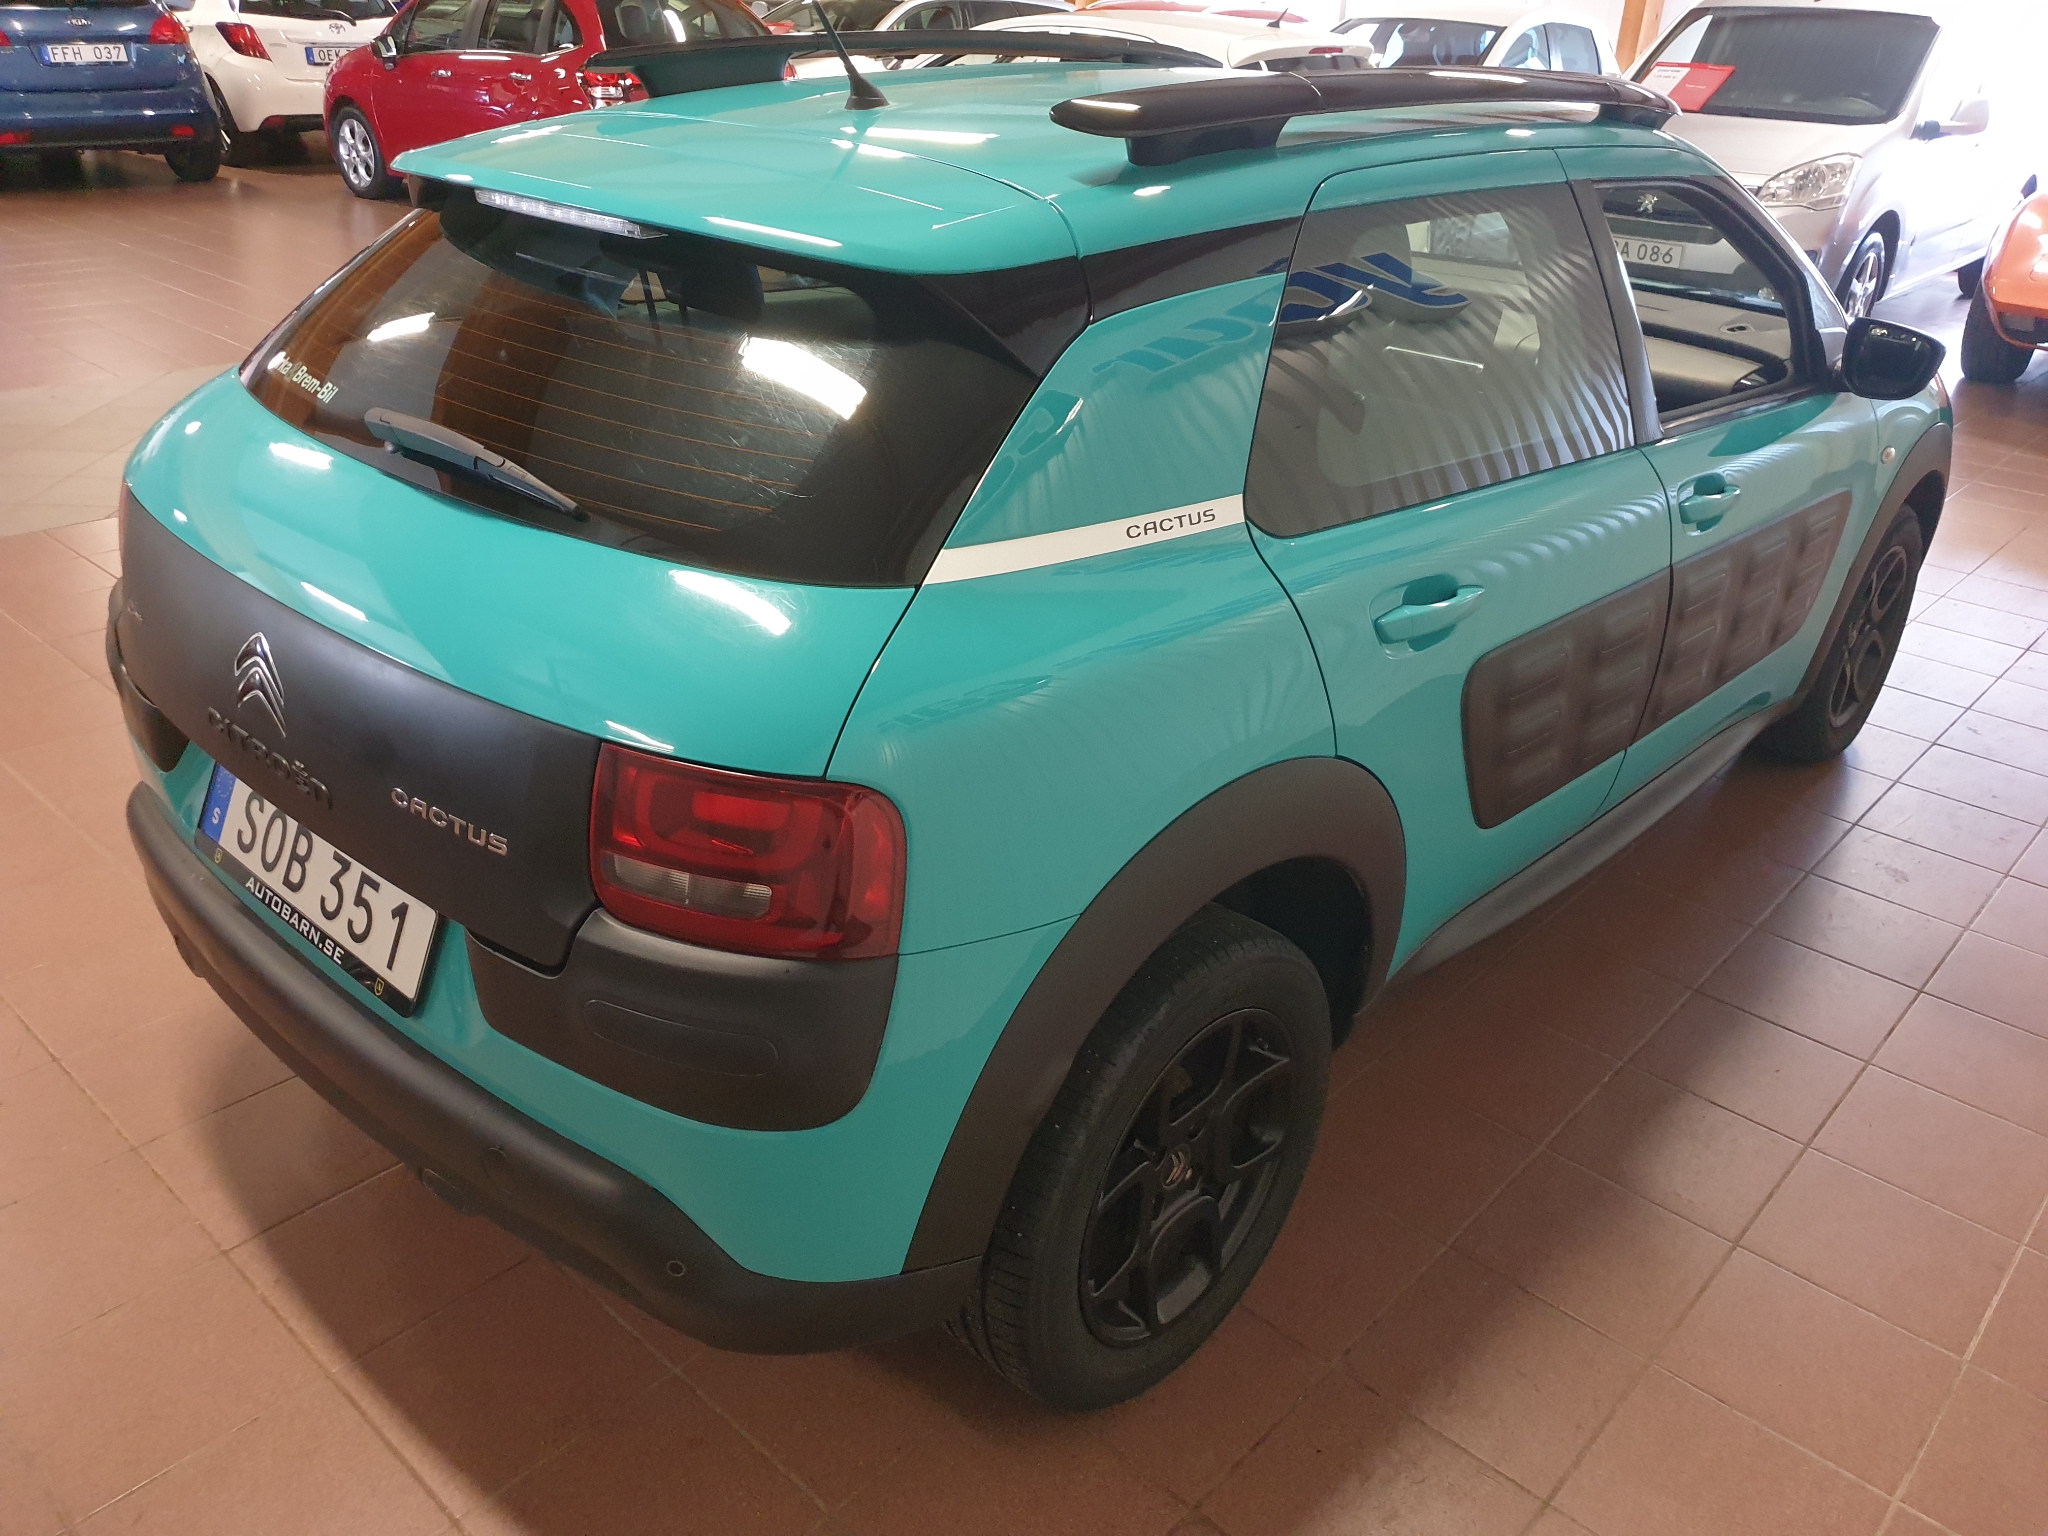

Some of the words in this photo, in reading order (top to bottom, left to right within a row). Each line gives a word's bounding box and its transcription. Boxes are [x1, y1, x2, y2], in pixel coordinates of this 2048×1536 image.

[50, 47, 83, 61] FFH
[93, 46, 121, 60] 037
[1637, 243, 1673, 264] 086
[292, 365, 339, 404] Brem-Bil
[1126, 508, 1216, 539] CACTUS
[211, 807, 221, 824] S
[390, 787, 508, 856] CACTUS
[236, 790, 314, 893] SOB
[320, 850, 410, 971] 351
[246, 876, 345, 966] AUTOBARN.SE
